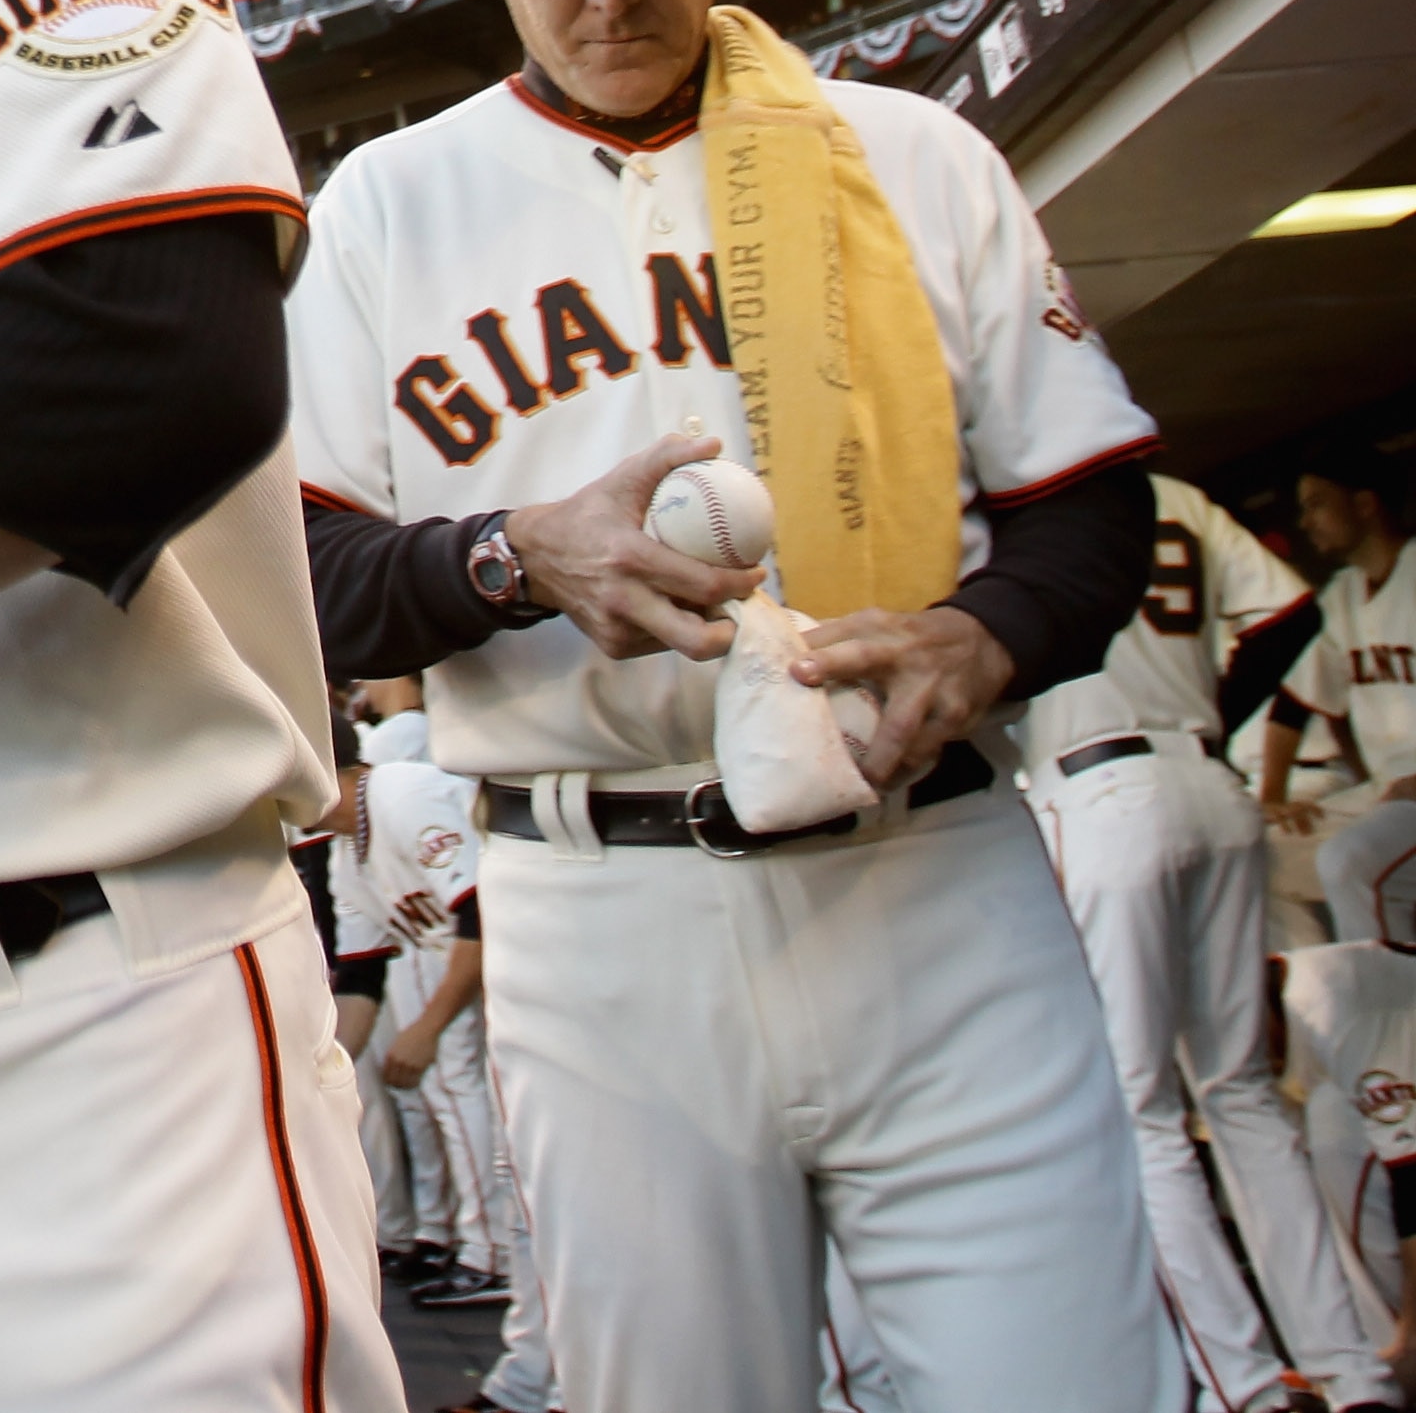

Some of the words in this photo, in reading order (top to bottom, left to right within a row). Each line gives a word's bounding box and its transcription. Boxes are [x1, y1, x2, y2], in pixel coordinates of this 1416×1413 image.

[15, 41, 152, 71] BASEBALL
[150, 4, 196, 48] CLUB
[727, 131, 764, 227] GYM.
[728, 240, 765, 352] YOUR
[393, 252, 735, 469] GIAN
